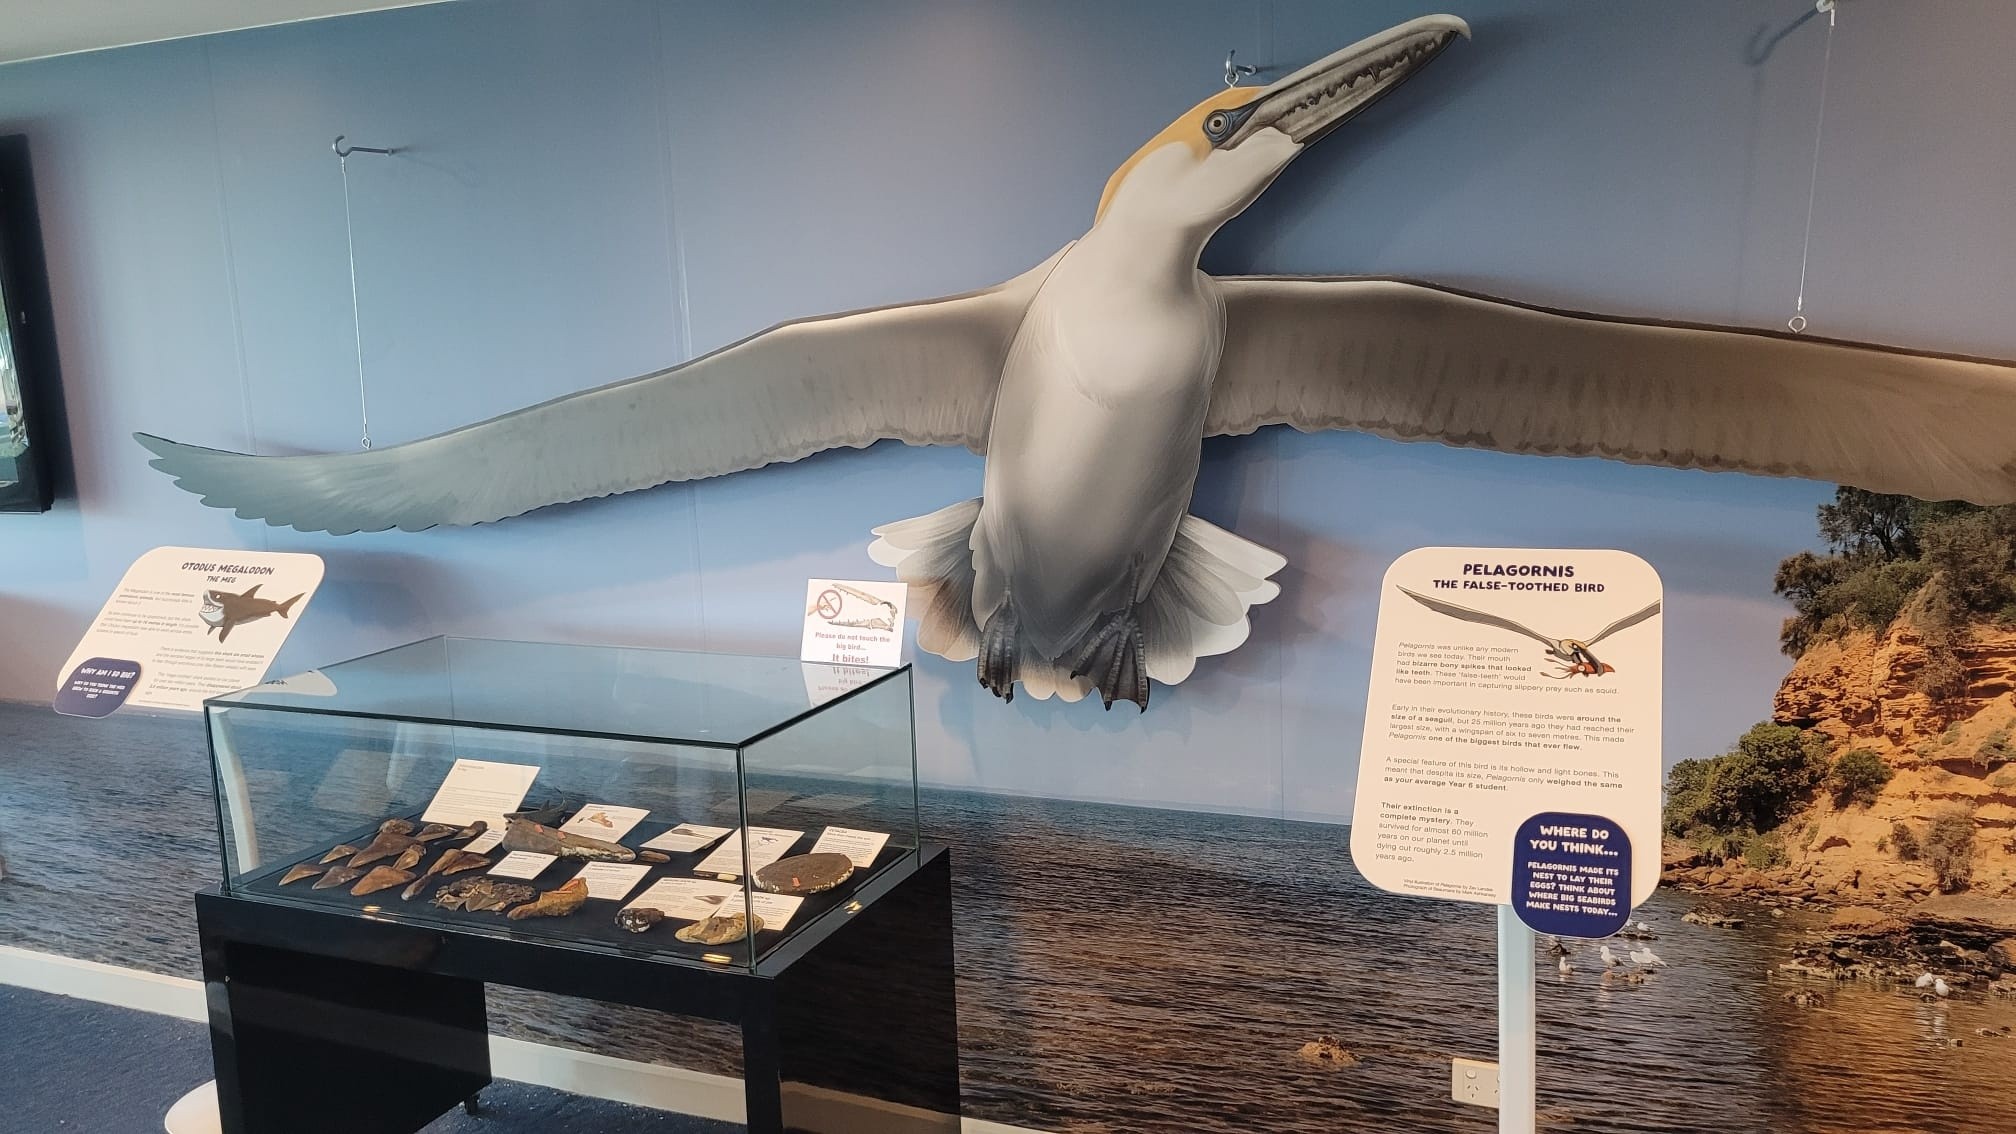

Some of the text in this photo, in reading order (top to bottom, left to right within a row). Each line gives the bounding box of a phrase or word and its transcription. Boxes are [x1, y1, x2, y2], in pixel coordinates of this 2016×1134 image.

[182, 562, 275, 576] OTODUS MEGALODON
[1463, 564, 1575, 577] PELAGORNIS
[222, 576, 236, 584] MEG
[1433, 580, 1605, 593] THE FALSE-TOOTHED BIRD
[1398, 641, 1435, 650] Pelagornis
[1475, 646, 1489, 654] any
[832, 653, 869, 664] It bites!
[1468, 653, 1485, 661] Their
[1412, 659, 1437, 667] bizarre
[1440, 661, 1459, 670] bony
[1461, 662, 1485, 670] spikes
[1505, 664, 1532, 672] looked
[1392, 704, 1409, 713] Early
[1437, 707, 1481, 717] evolutionary
[1531, 722, 1546, 730] ago
[1548, 722, 1564, 731] they
[1617, 726, 1635, 734] their
[1388, 732, 1426, 741] Pelagornis
[1470, 737, 1500, 746] biggest
[1502, 739, 1522, 747] birds
[1393, 757, 1419, 765] special
[1421, 758, 1446, 766] feature
[1511, 764, 1535, 772] hollow
[1554, 767, 1571, 776] light
[1395, 777, 1412, 785] your
[1415, 779, 1446, 788] average
[1448, 780, 1466, 788] Year
[1426, 769, 1454, 778] despite
[1486, 773, 1525, 782] Pelagornis
[1528, 776, 1544, 785] only
[1546, 778, 1581, 787] weighed
[1381, 802, 1401, 810] Their
[1403, 804, 1442, 813] extinction
[1380, 813, 1416, 821] complete
[1455, 818, 1474, 828] They
[1378, 823, 1409, 831] survived
[1424, 826, 1449, 834] almost
[1463, 830, 1489, 838] million
[1540, 825, 1609, 839] WHERE DO
[1426, 836, 1450, 844] planet
[1376, 842, 1397, 852] dying
[1413, 847, 1441, 856] roughly
[1443, 848, 1456, 856] 2.5
[1458, 850, 1483, 858] million
[1529, 839, 1618, 856] YOU THINK...
[1528, 861, 1619, 876] PELAGORNIS MADE ITS
[1570, 875, 1586, 883] LAY
[1588, 877, 1613, 885] THEIR
[1530, 881, 1615, 895] EGGS? THINK ABOUT
[1529, 891, 1558, 900] WHERE
[1577, 896, 1616, 905] SEABIRDS
[1526, 901, 1618, 916] MAKE NESTS TODAY...
